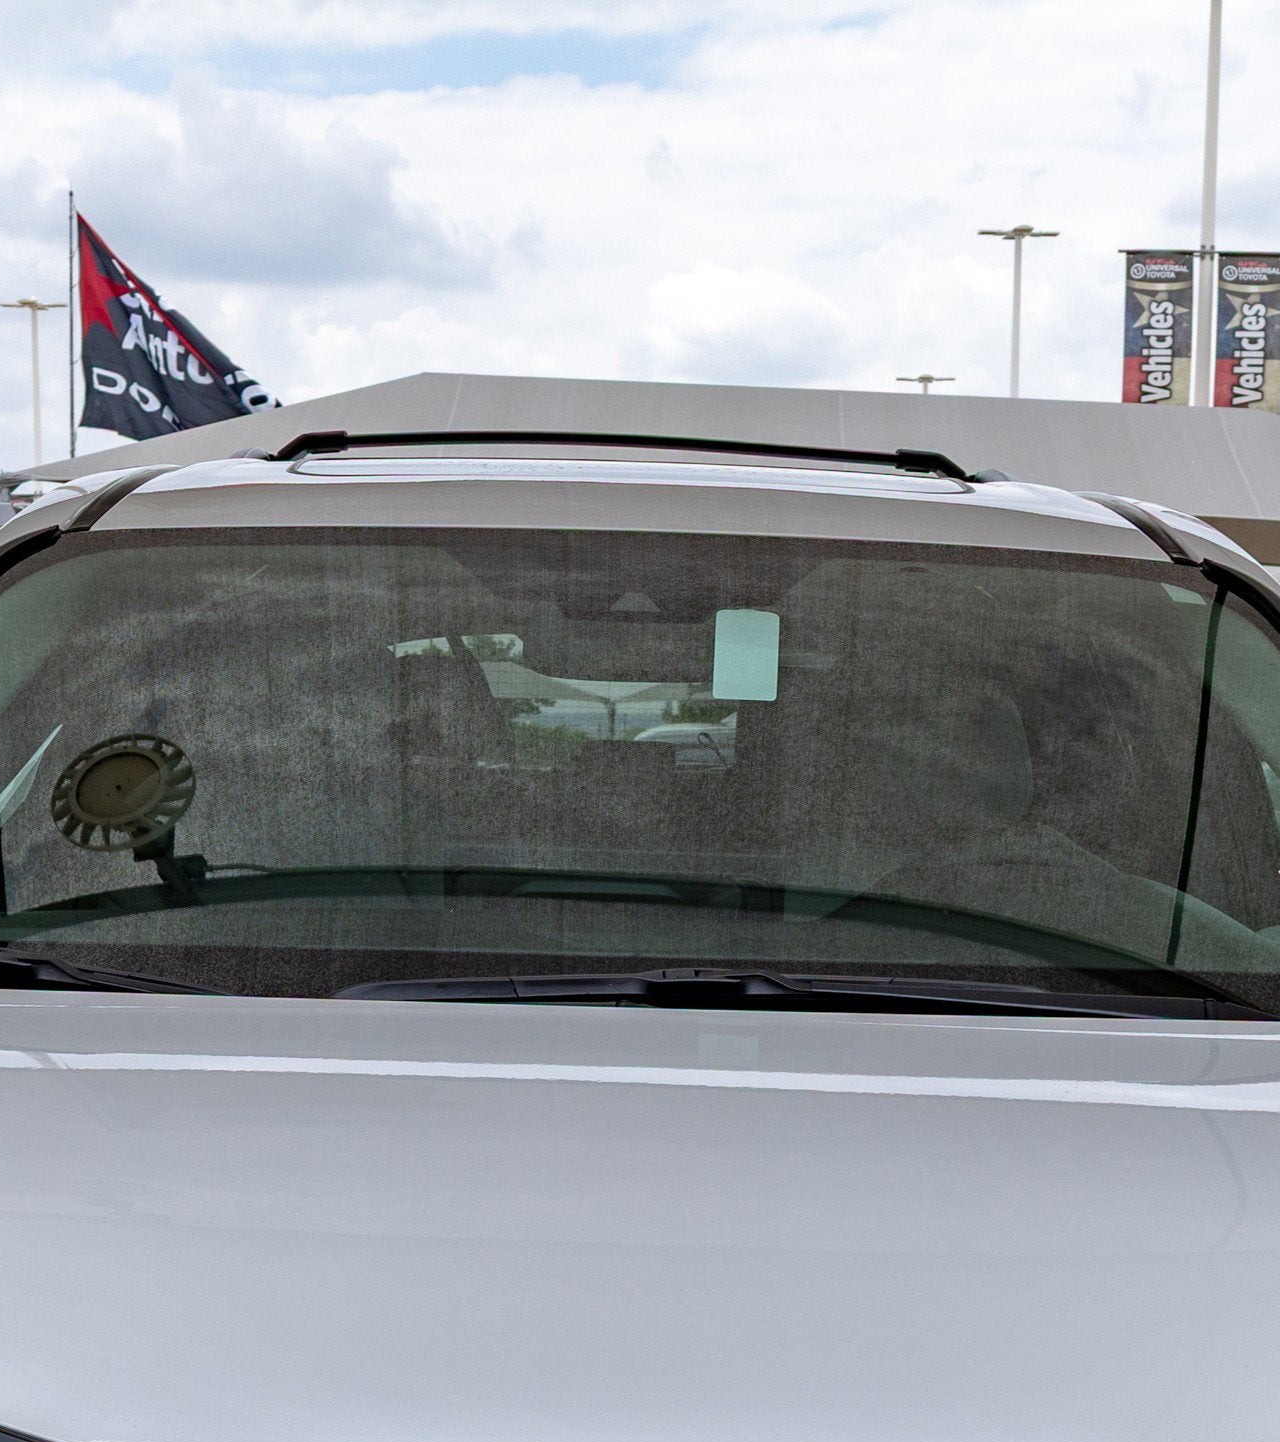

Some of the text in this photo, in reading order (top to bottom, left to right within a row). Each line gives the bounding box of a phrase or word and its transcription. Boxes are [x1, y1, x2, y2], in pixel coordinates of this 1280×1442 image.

[1145, 264, 1189, 273] UNIVERSAL
[1141, 301, 1174, 402] Vehicles
[1232, 303, 1267, 405] Vehicles
